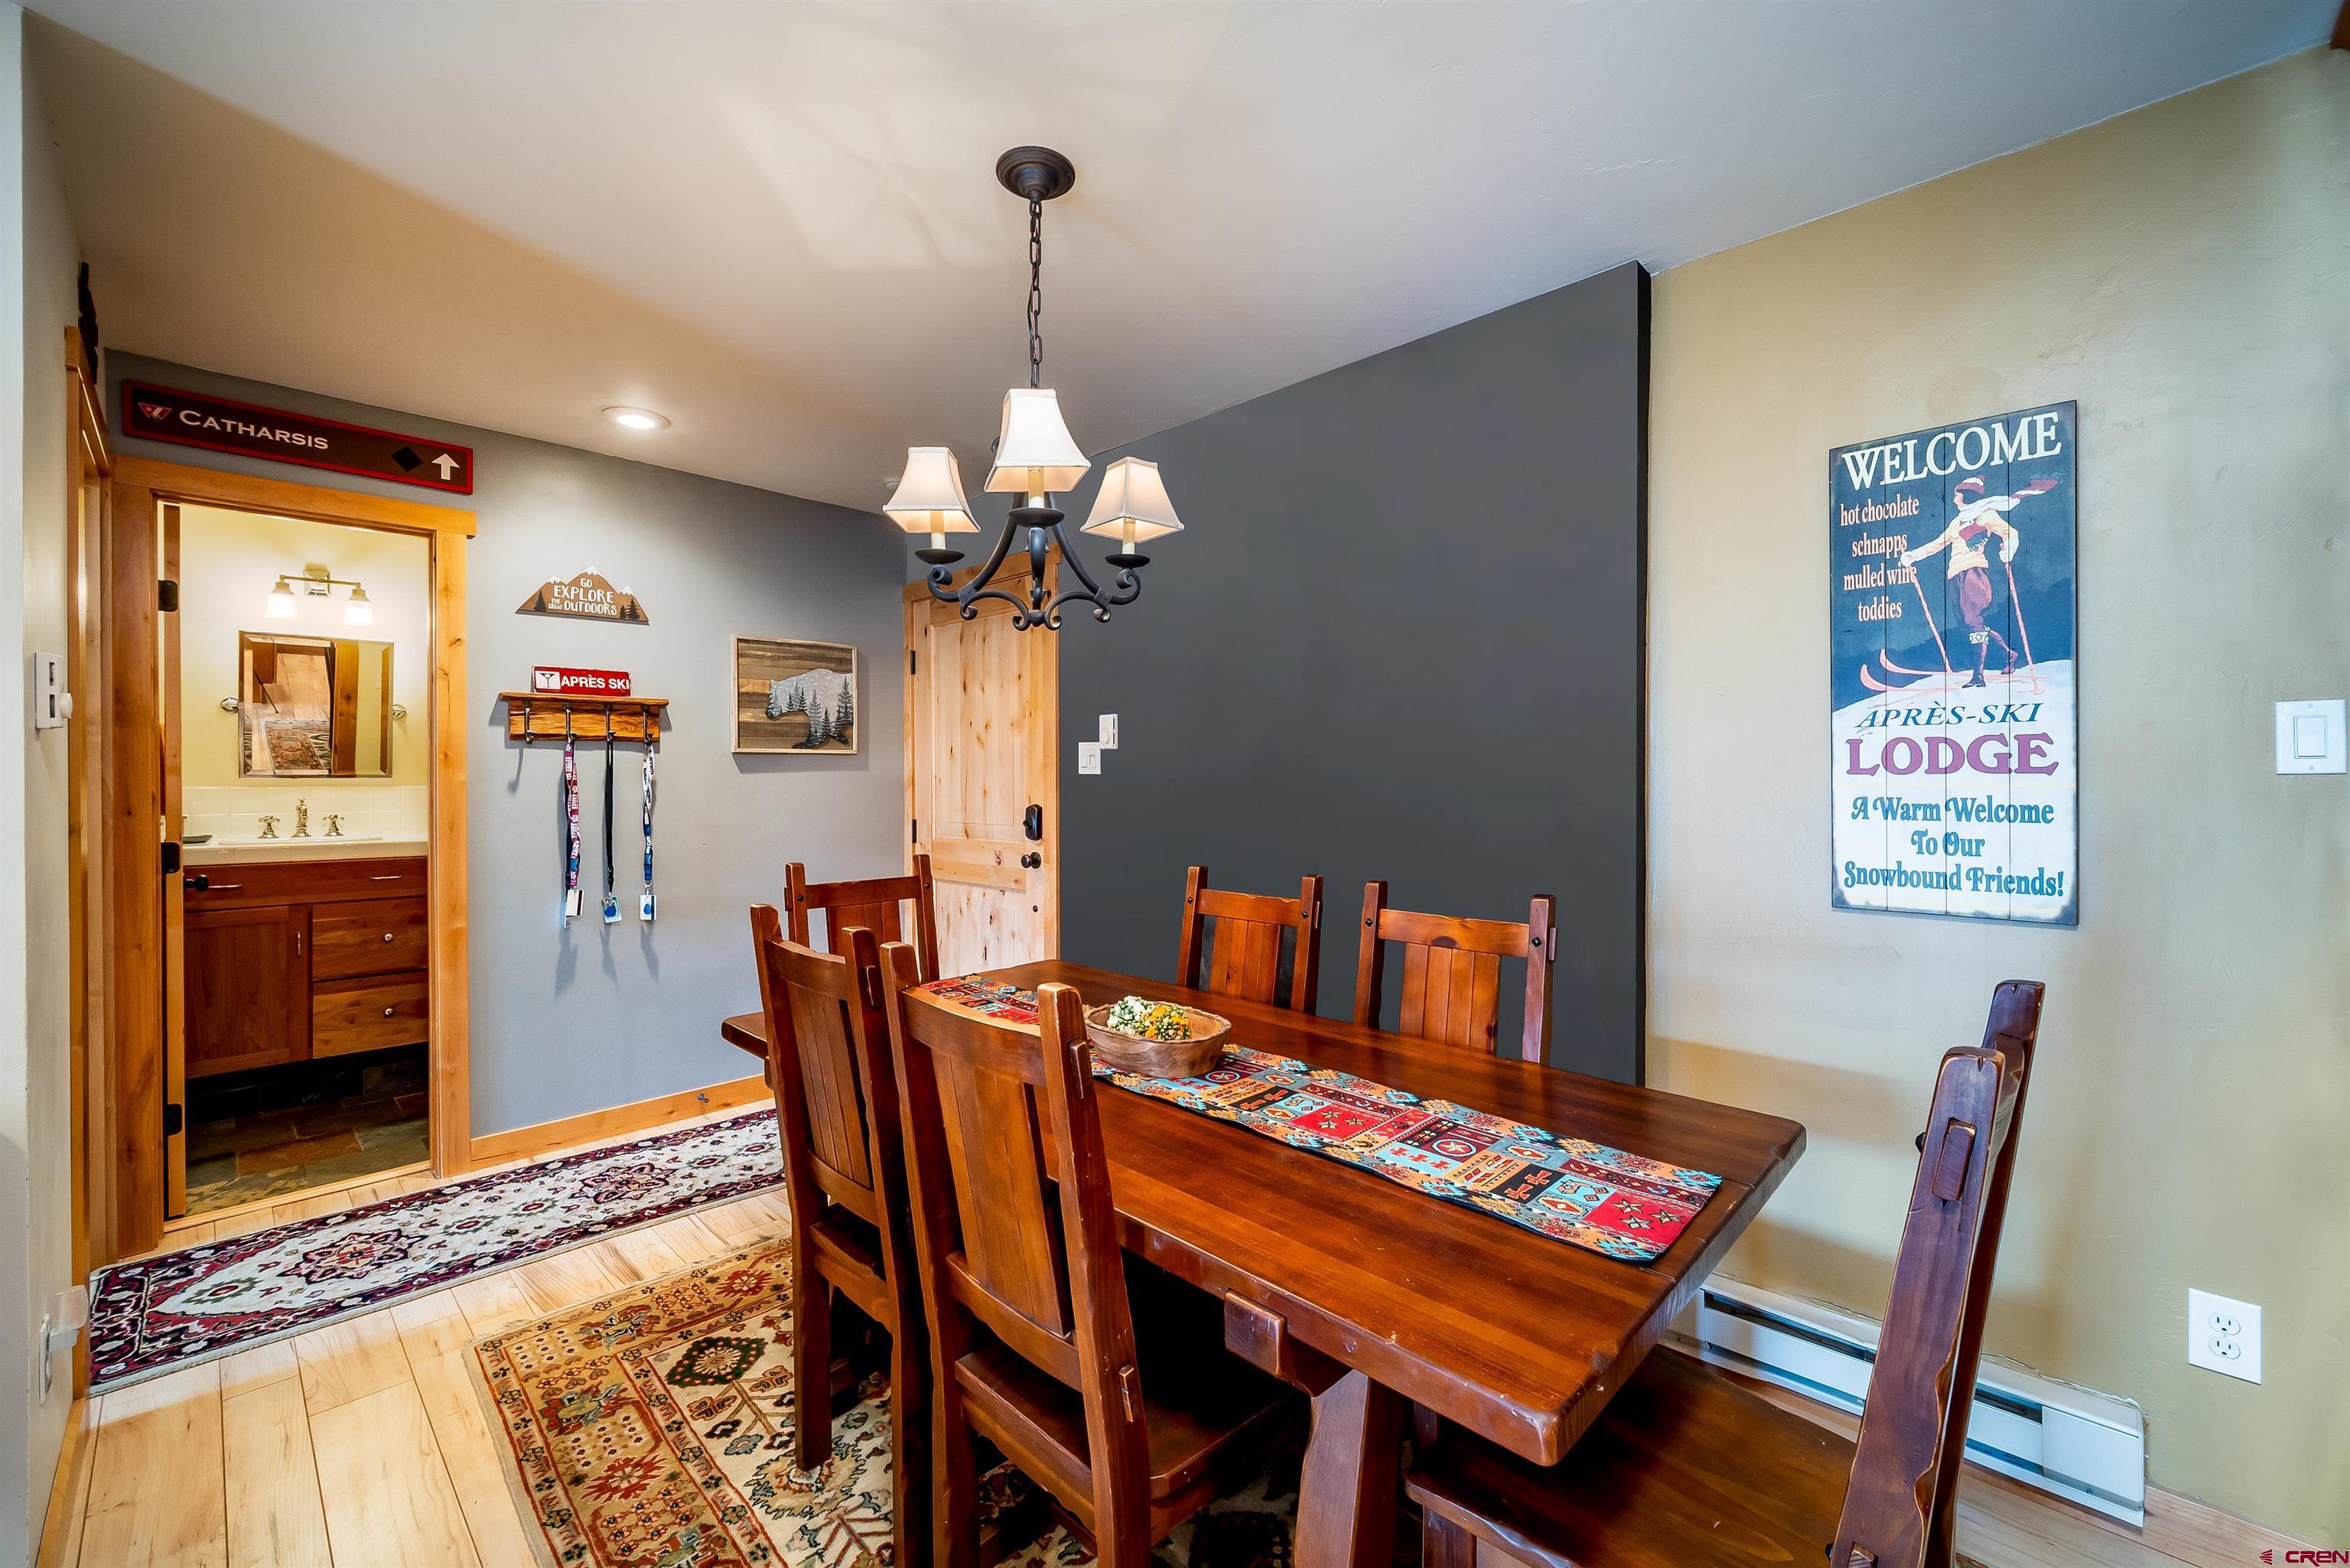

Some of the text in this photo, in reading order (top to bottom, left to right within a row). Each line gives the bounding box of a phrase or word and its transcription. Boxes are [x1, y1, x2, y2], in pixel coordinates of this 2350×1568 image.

[1842, 412, 2062, 490] WELCOME
[1841, 493, 1920, 526] hot chocolate
[1852, 533, 1908, 559] schnapps
[580, 578, 592, 587] GO
[1844, 561, 1917, 591] mulled wine
[554, 585, 614, 603] EXPLORE
[564, 601, 617, 616] OUTDOORS
[1857, 598, 1902, 622] toddies
[561, 673, 630, 690] APRÈS SKI
[1855, 701, 2045, 728] APRÈS-SKI
[1845, 733, 2059, 776] LODGE
[1851, 795, 2054, 824] A Warm Welcome
[1911, 828, 1986, 857] To Our
[1844, 860, 2065, 897] Snowbound Friends!
